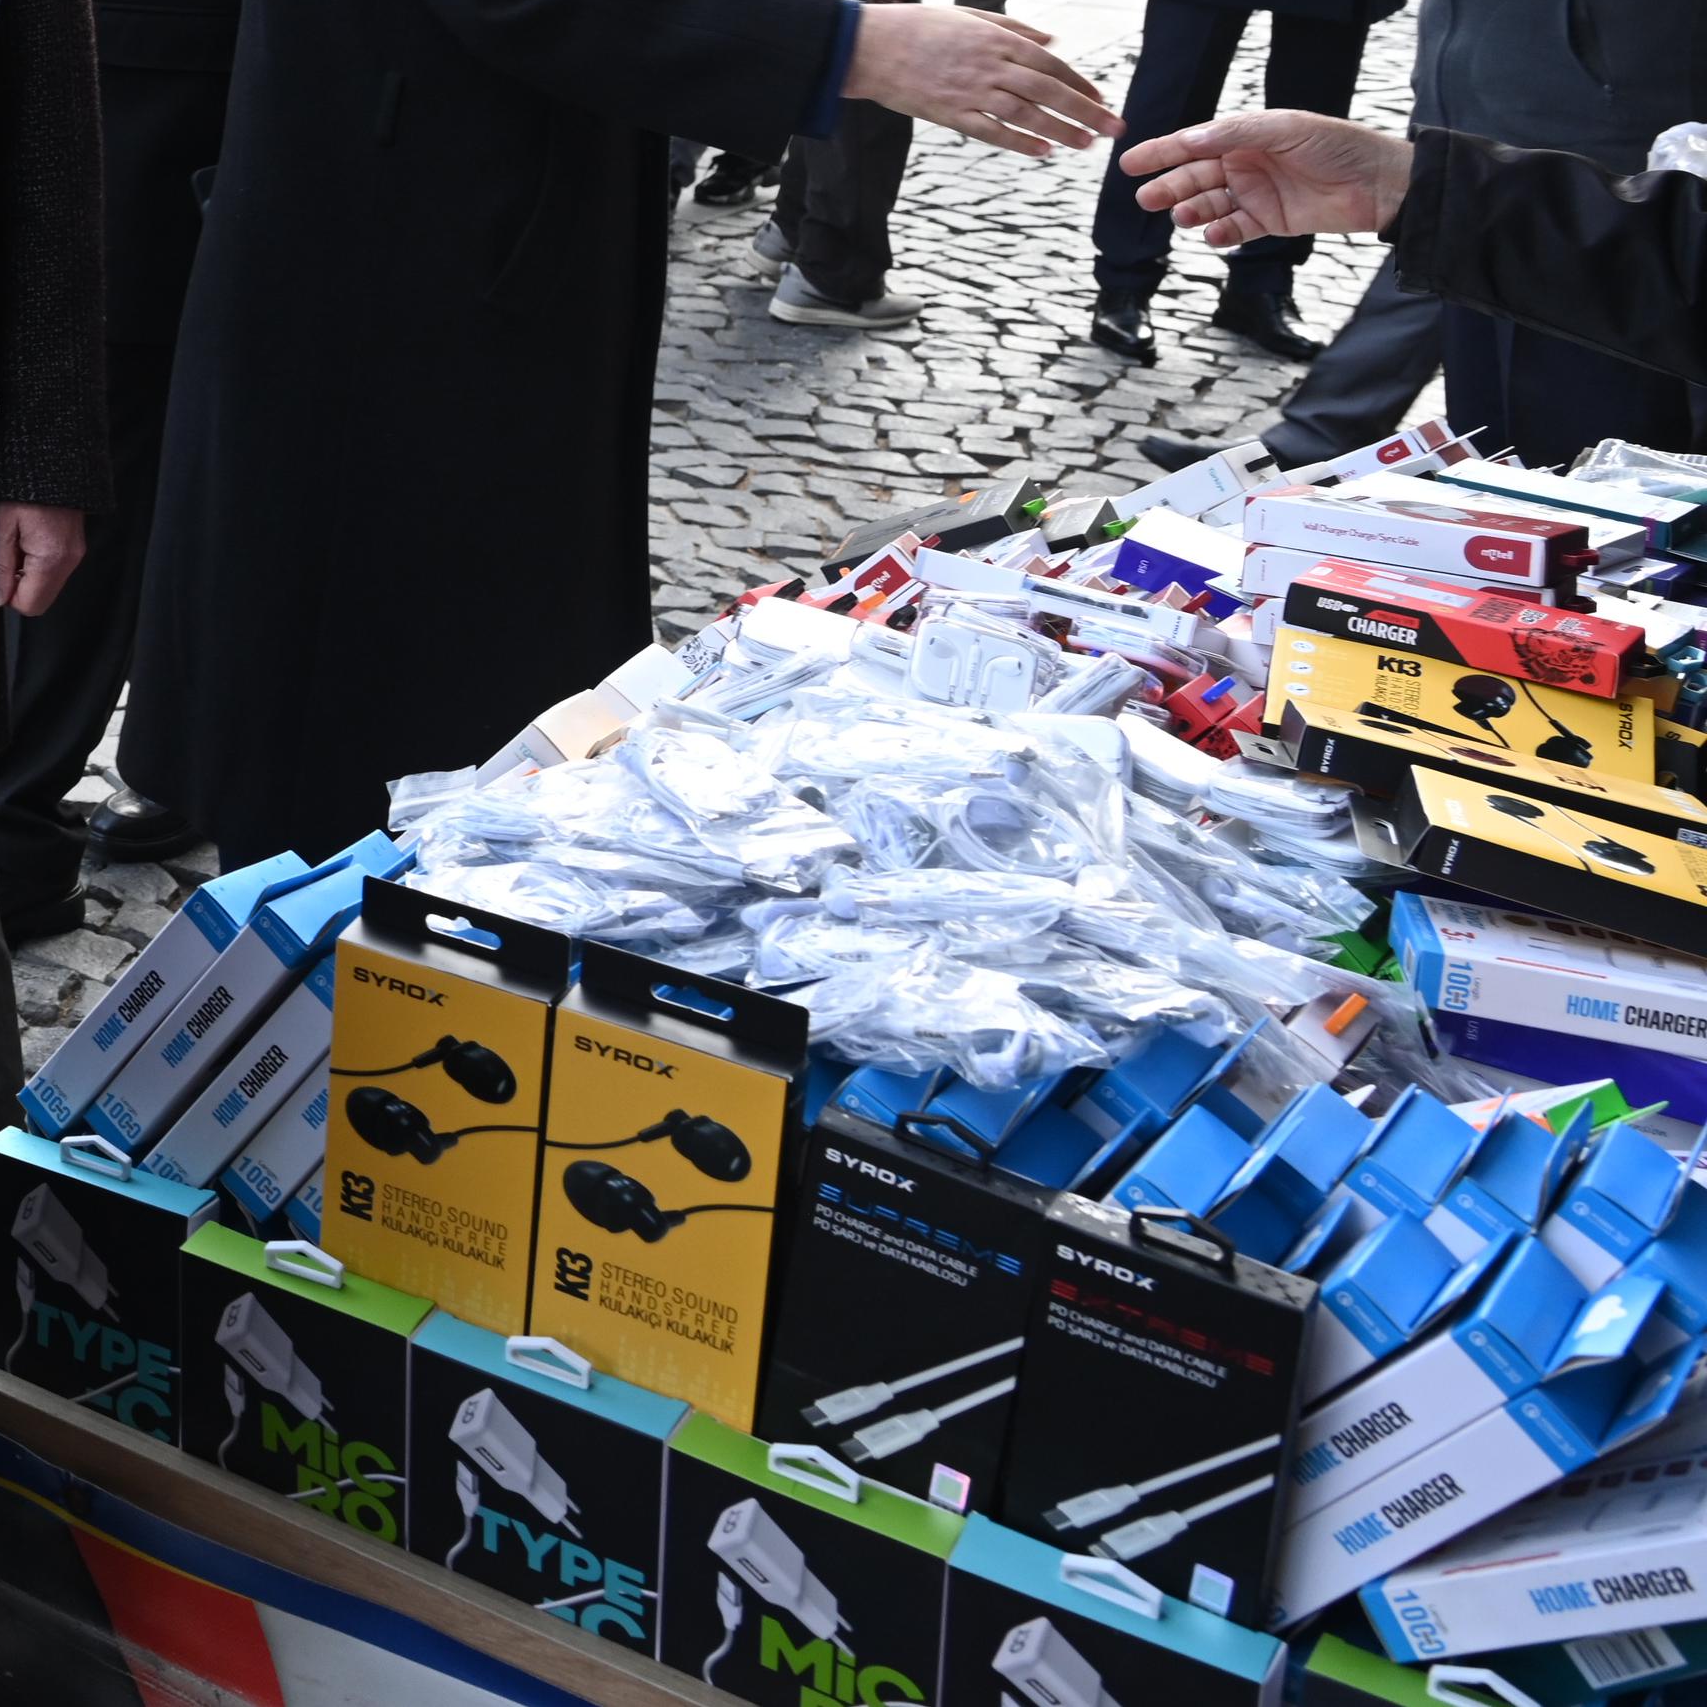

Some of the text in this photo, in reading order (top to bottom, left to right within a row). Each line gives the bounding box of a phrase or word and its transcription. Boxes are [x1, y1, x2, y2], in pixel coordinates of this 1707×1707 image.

[1321, 524, 1349, 537] Charger
[1399, 535, 1419, 547] Cable
[1347, 616, 1417, 645] CHARGER
[1377, 655, 1422, 678] K13
[1320, 737, 1336, 773] SYROX
[1618, 704, 1633, 750] SYROX
[1441, 839, 1461, 875] SYROX
[92, 970, 167, 1052] HOME CHARGER
[352, 964, 450, 1008] SYROX
[160, 1028, 196, 1068] HOME
[186, 985, 235, 1038] CHARGER
[1566, 994, 1707, 1038] HOME CHARGER
[573, 1033, 680, 1081] SYROX
[211, 1044, 289, 1129] HOME CHARGER
[301, 1088, 328, 1130] HOM
[340, 1170, 375, 1222] K13
[824, 1146, 918, 1193] SYROX
[382, 1183, 508, 1241] STEREO SOUND
[817, 1182, 1023, 1277] SUPREME
[442, 1238, 506, 1272] KULAKLIK
[813, 1216, 831, 1231] PD
[863, 1238, 877, 1250] ve
[877, 1243, 910, 1263] DATA
[911, 1257, 969, 1287] KABLOSU
[815, 1203, 979, 1278] PD CHARGE and DATA CABLE
[1056, 1244, 1160, 1291] SYROX
[554, 1246, 593, 1302] K13
[601, 1262, 739, 1325] STEREO SOUND
[30, 1300, 173, 1394] TYPE
[665, 1319, 735, 1355] KULAKLIK
[1047, 1315, 1066, 1331] PD
[1101, 1338, 1118, 1350] ve
[1118, 1342, 1153, 1364] DATA
[1153, 1357, 1218, 1388] KABLOSU
[1049, 1301, 1228, 1378] PD CHARGE and DATA CABLE
[1050, 1278, 1275, 1376] EXTREME
[1330, 1401, 1414, 1460] CHARGER
[295, 1466, 397, 1545] RO
[1332, 1472, 1465, 1556] HOME CHARGER
[473, 1504, 647, 1615] TYPE
[1528, 1566, 1695, 1615] HOME CHARGER
